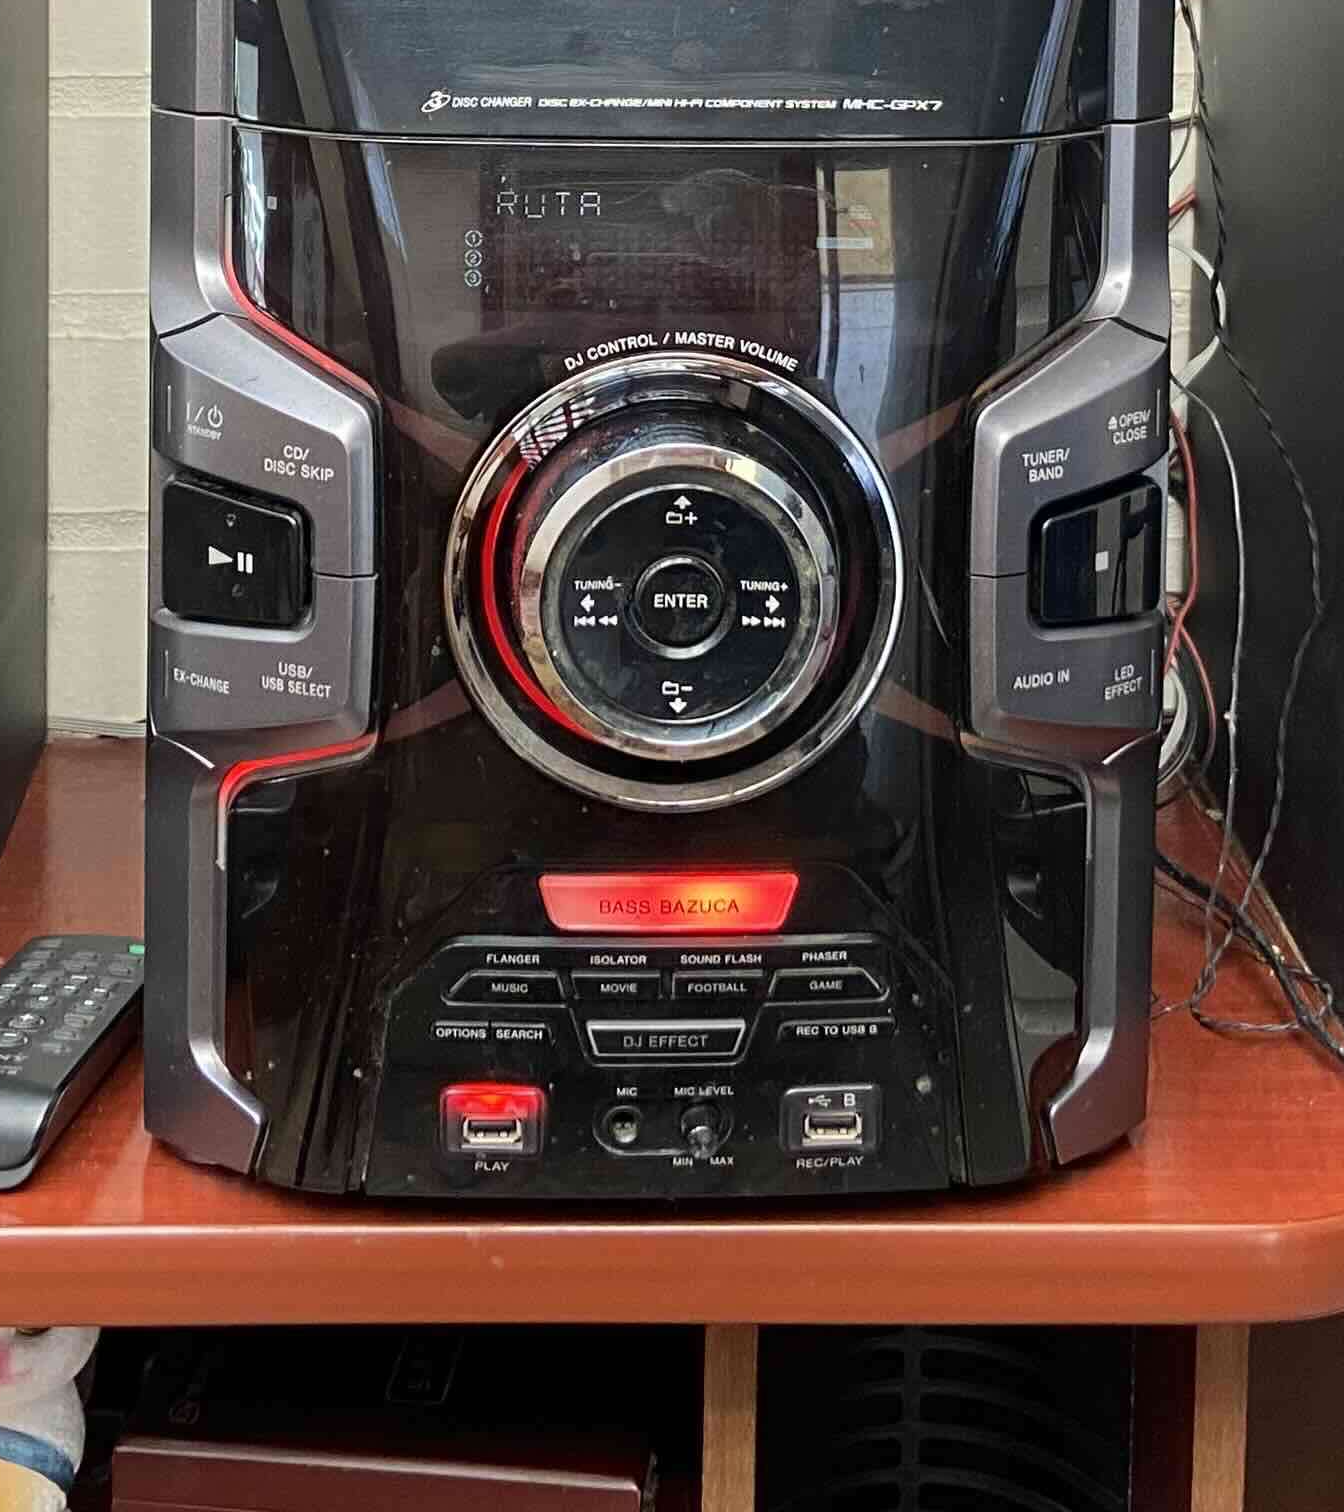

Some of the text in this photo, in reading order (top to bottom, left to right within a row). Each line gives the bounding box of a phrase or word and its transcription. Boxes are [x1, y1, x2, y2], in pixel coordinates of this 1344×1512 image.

[452, 96, 478, 108] DISC
[480, 96, 532, 108] CHANGER
[538, 98, 568, 108] DISC
[674, 98, 703, 108] HI-FI
[705, 99, 784, 109] COMPONENT
[785, 99, 837, 110] SYSTEM
[842, 99, 943, 111] MHC-GPX7
[564, 353, 585, 371] DJ
[587, 333, 658, 361] CONTROL
[675, 332, 735, 351] MASTER
[740, 339, 799, 373] VOLUME
[1119, 409, 1151, 428] OPEN/
[1112, 426, 1148, 445] CLOSE
[283, 445, 310, 460] CD/
[1022, 448, 1071, 467] TUNER/
[263, 458, 334, 481] DISC SKIP
[1028, 466, 1064, 483] BAND
[653, 593, 708, 609] ENTER
[278, 661, 313, 680] USB/
[1114, 664, 1135, 682] LED
[173, 667, 230, 695] EX-CHANGE
[1013, 668, 1071, 690] AUDIO IN
[261, 675, 332, 699] USB SELECT
[1104, 676, 1143, 701] EFFECT
[599, 898, 740, 915] BASS BAZUCA
[486, 953, 540, 965] FLANGER
[589, 954, 648, 966] ISOLATOR
[680, 953, 763, 965] SOUND FLASH
[801, 950, 848, 962] PHASER
[491, 982, 529, 994] MUSIC
[600, 982, 638, 994] MOVIE
[687, 982, 748, 994] FOOTBALL
[809, 980, 844, 991] GAME
[435, 1027, 487, 1039] OPTIONS
[495, 1029, 544, 1040] SEARCH
[796, 1025, 820, 1037] REC
[823, 1025, 839, 1036] TO
[842, 1024, 866, 1036] USB
[623, 1034, 709, 1049] DJ EFFECT
[616, 1087, 638, 1097] MIC
[674, 1085, 734, 1097] MIC LEVEL
[843, 1092, 857, 1107] B
[474, 1160, 510, 1172] PLAY
[672, 1156, 735, 1167] MIN MAX
[795, 1155, 865, 1170] REC/PLAY
